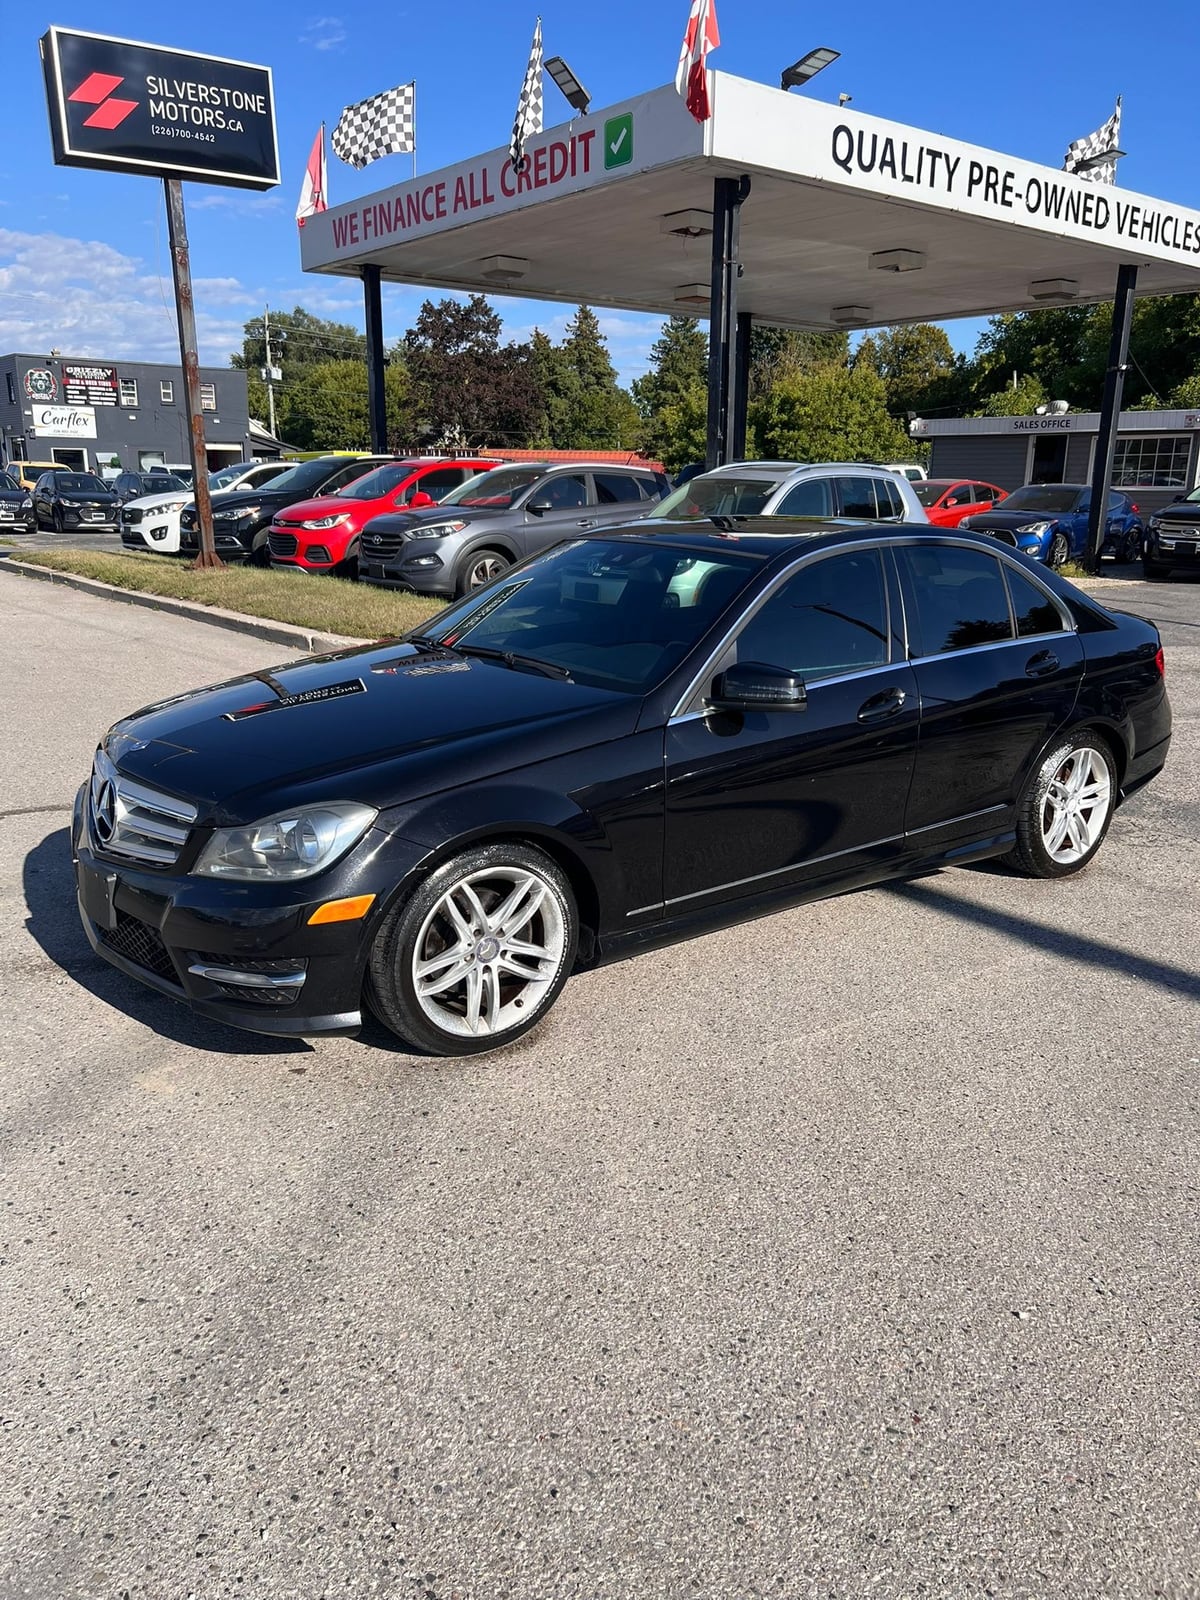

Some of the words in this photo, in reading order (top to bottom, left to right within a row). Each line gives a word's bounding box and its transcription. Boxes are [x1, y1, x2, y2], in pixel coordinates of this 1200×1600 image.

[146, 75, 267, 115] SILVERSTONE
[151, 124, 216, 143] (226)700-4542
[332, 212, 360, 249] WE
[363, 182, 447, 241] FINANCE
[453, 167, 495, 214] ALL
[500, 129, 596, 198] CREDIT
[831, 124, 962, 193] QUALITY
[966, 160, 1110, 231] PRE-OWNED
[1116, 200, 1200, 254] VEHICLES
[66, 366, 113, 377] GRIZZLY
[41, 410, 89, 429] Carflex
[1014, 420, 1040, 429] SALES
[1041, 419, 1071, 429] OFFICE
